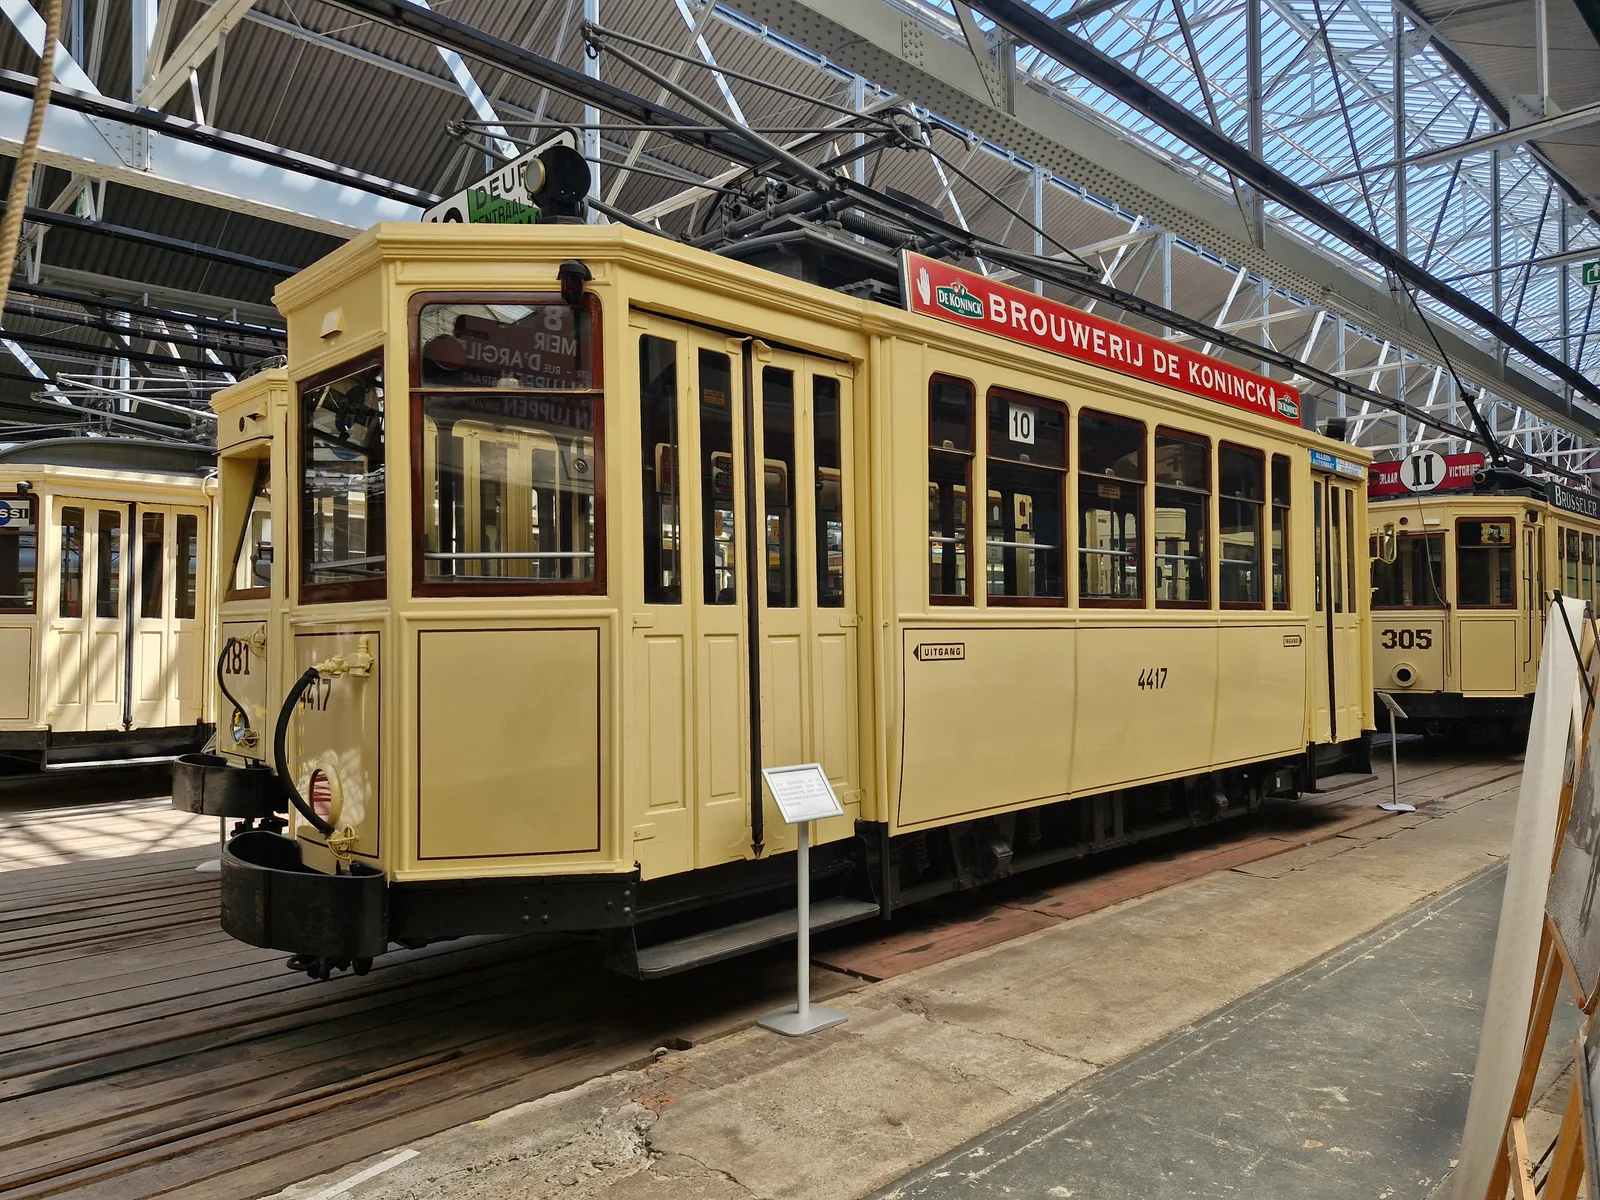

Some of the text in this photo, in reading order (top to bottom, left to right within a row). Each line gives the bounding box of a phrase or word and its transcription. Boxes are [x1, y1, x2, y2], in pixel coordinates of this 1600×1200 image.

[938, 290, 983, 316] DE KONINCK
[988, 292, 1267, 407] BROUWERIJ DE KONINCK
[1013, 411, 1030, 439] 10
[924, 647, 961, 657] UITGANG
[1381, 629, 1433, 650] 305
[1137, 667, 1168, 691] 4417
